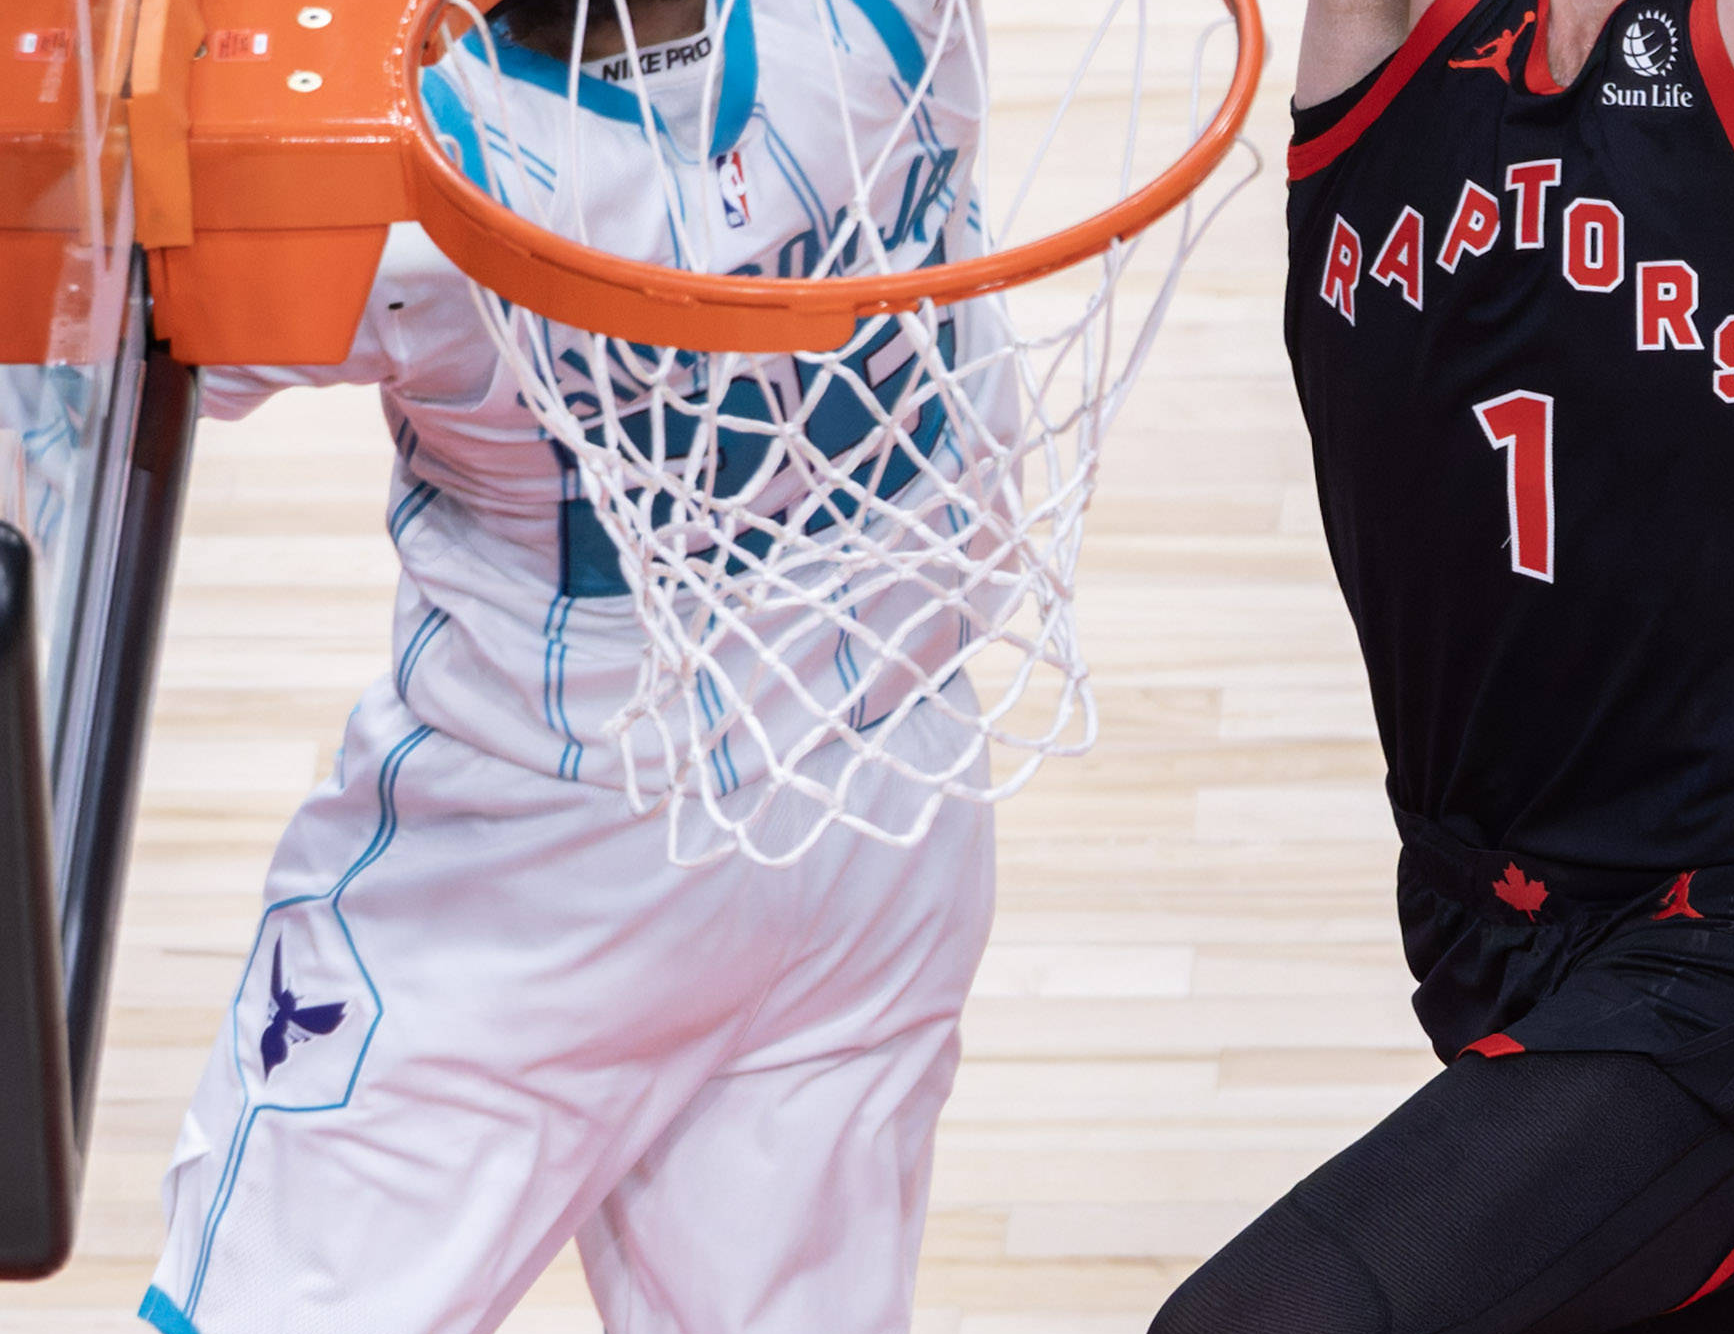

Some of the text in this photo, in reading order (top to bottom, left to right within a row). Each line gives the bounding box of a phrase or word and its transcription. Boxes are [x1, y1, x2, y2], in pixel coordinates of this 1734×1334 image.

[602, 36, 713, 82] NIKE PRO
[1601, 82, 1694, 108] Sun Life
[1472, 389, 1554, 583] 1
